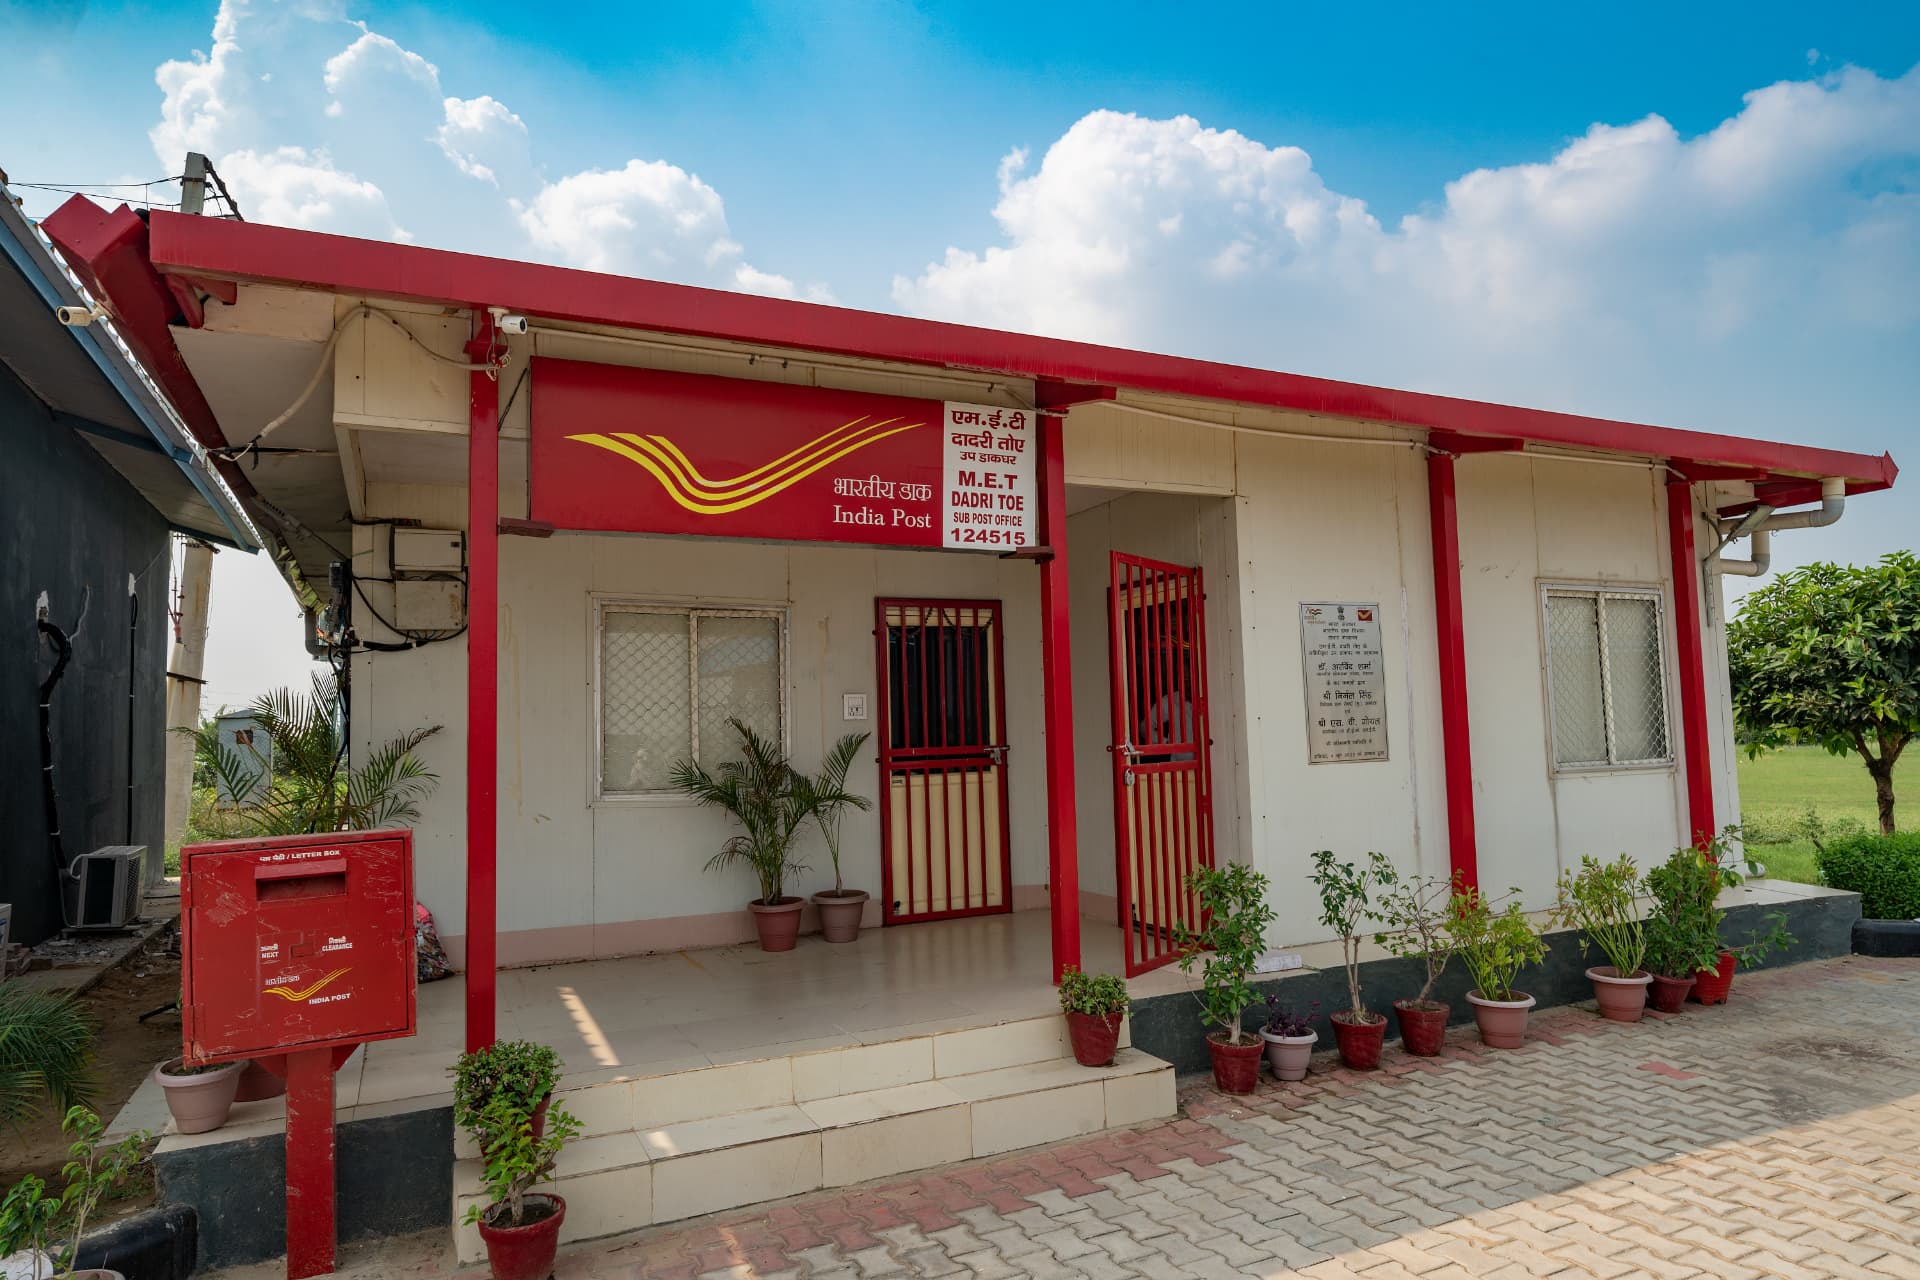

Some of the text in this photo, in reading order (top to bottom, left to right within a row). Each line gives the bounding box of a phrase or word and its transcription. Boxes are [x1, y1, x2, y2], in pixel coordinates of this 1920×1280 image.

[952, 410, 1026, 430] एम.ई.टी
[952, 431, 1026, 452] दादरी तोए
[960, 452, 1016, 464] उप डाकघर
[834, 475, 933, 501] भारतीय डाक
[958, 471, 1018, 489] M.E.T
[952, 491, 1024, 511] DADRI TOE
[833, 505, 932, 528] India Post
[953, 512, 1022, 526] SUB POST OFFICE
[951, 528, 1025, 545] 124515
[291, 851, 322, 859] LETTER
[322, 943, 352, 951] CLEARANCE
[309, 993, 351, 1005] INDIA POST
